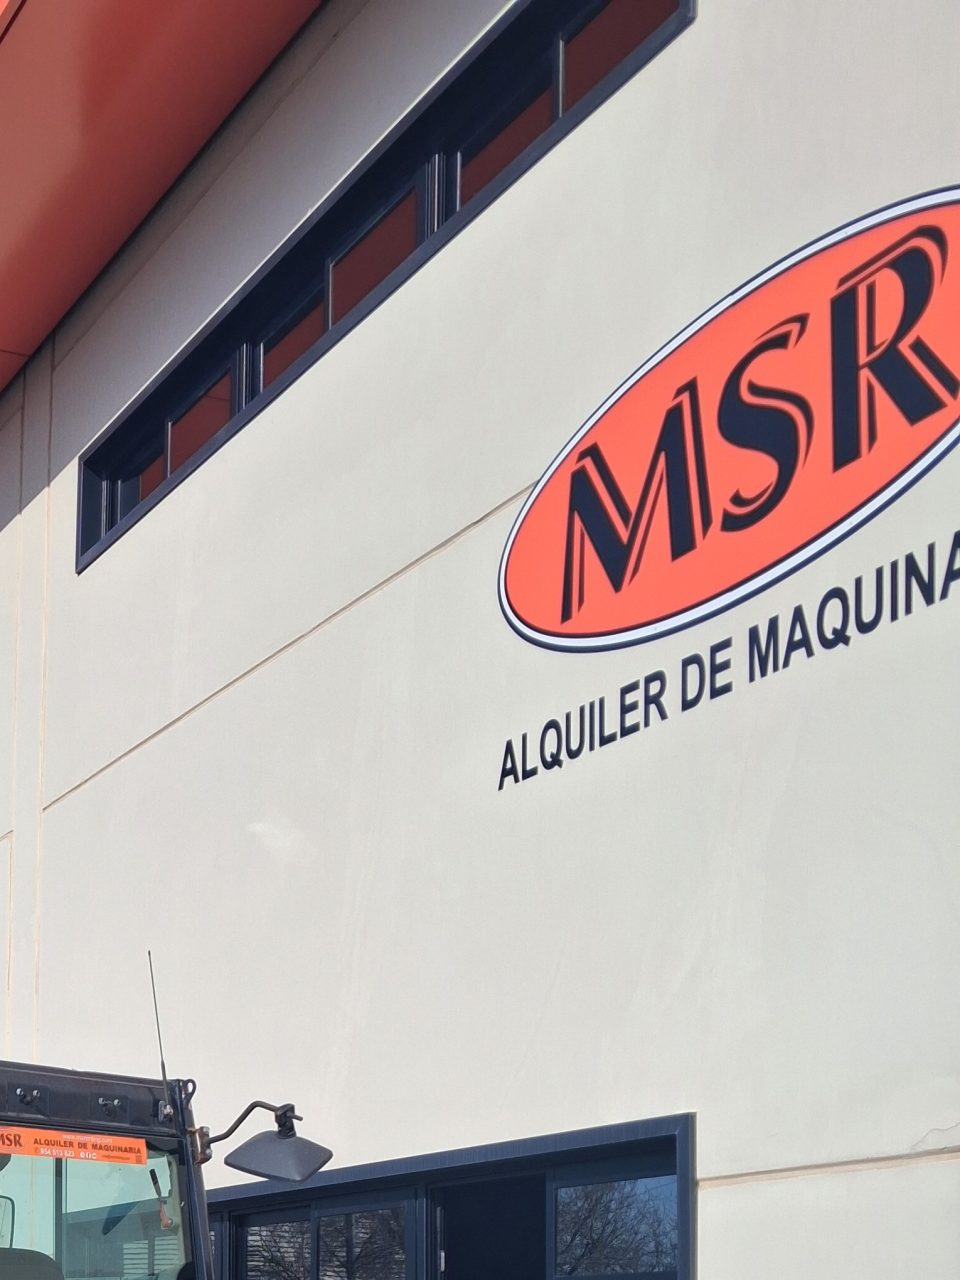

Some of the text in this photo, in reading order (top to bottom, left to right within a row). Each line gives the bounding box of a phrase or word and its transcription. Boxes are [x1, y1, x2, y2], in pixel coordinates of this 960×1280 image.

[561, 225, 960, 624] MSR
[498, 669, 668, 791] ALQUILER
[681, 636, 733, 712] DE
[33, 1138, 74, 1149] ALQUILER
[78, 1141, 89, 1149] DE
[91, 1142, 142, 1154] MAQUINARIA
